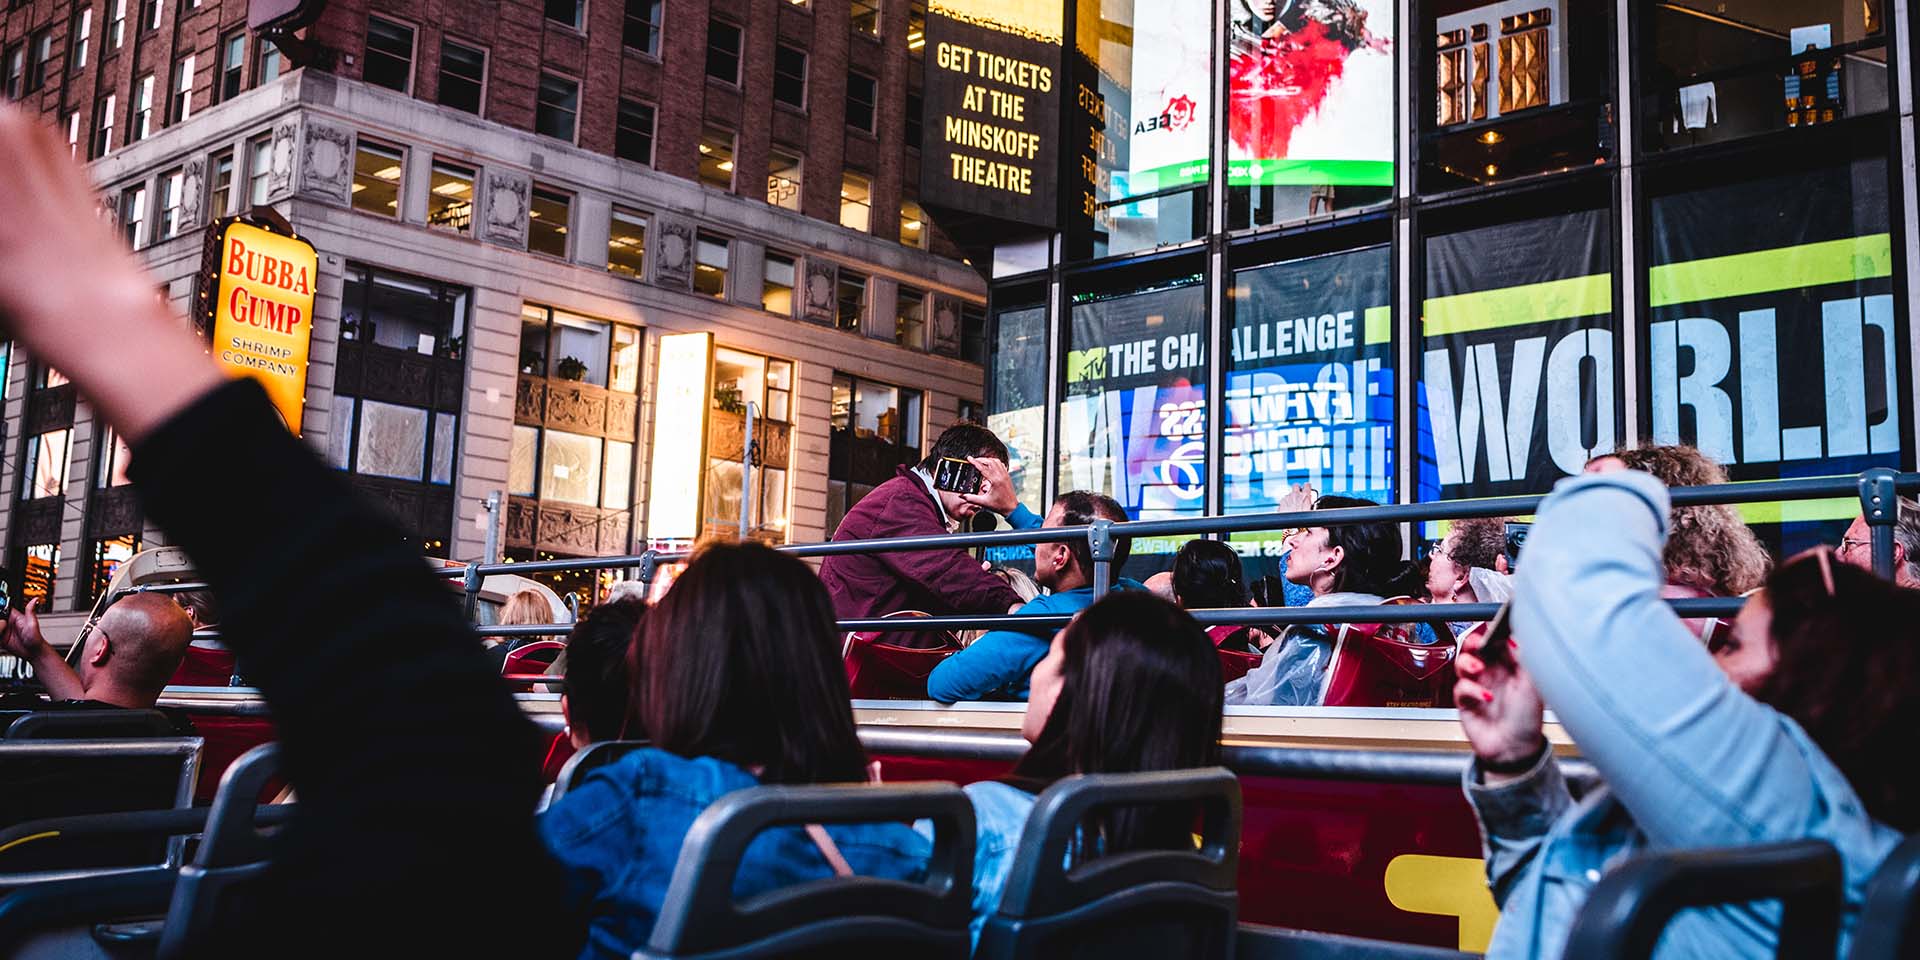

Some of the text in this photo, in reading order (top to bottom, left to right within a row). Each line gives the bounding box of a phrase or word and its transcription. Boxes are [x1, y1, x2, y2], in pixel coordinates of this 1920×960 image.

[937, 42, 1052, 92] GET TICKETS
[962, 84, 1025, 122] AT THE
[945, 115, 1040, 160] MINSKOFF
[950, 153, 1032, 195] THEATRE
[227, 237, 310, 295] BUBBA
[230, 286, 301, 335] GUMP
[222, 350, 297, 376] COMPANY
[232, 336, 292, 358] SHRIMP
[1067, 347, 1107, 383] MTV
[1108, 339, 1157, 377] THE
[1424, 294, 1899, 485] WORLD
